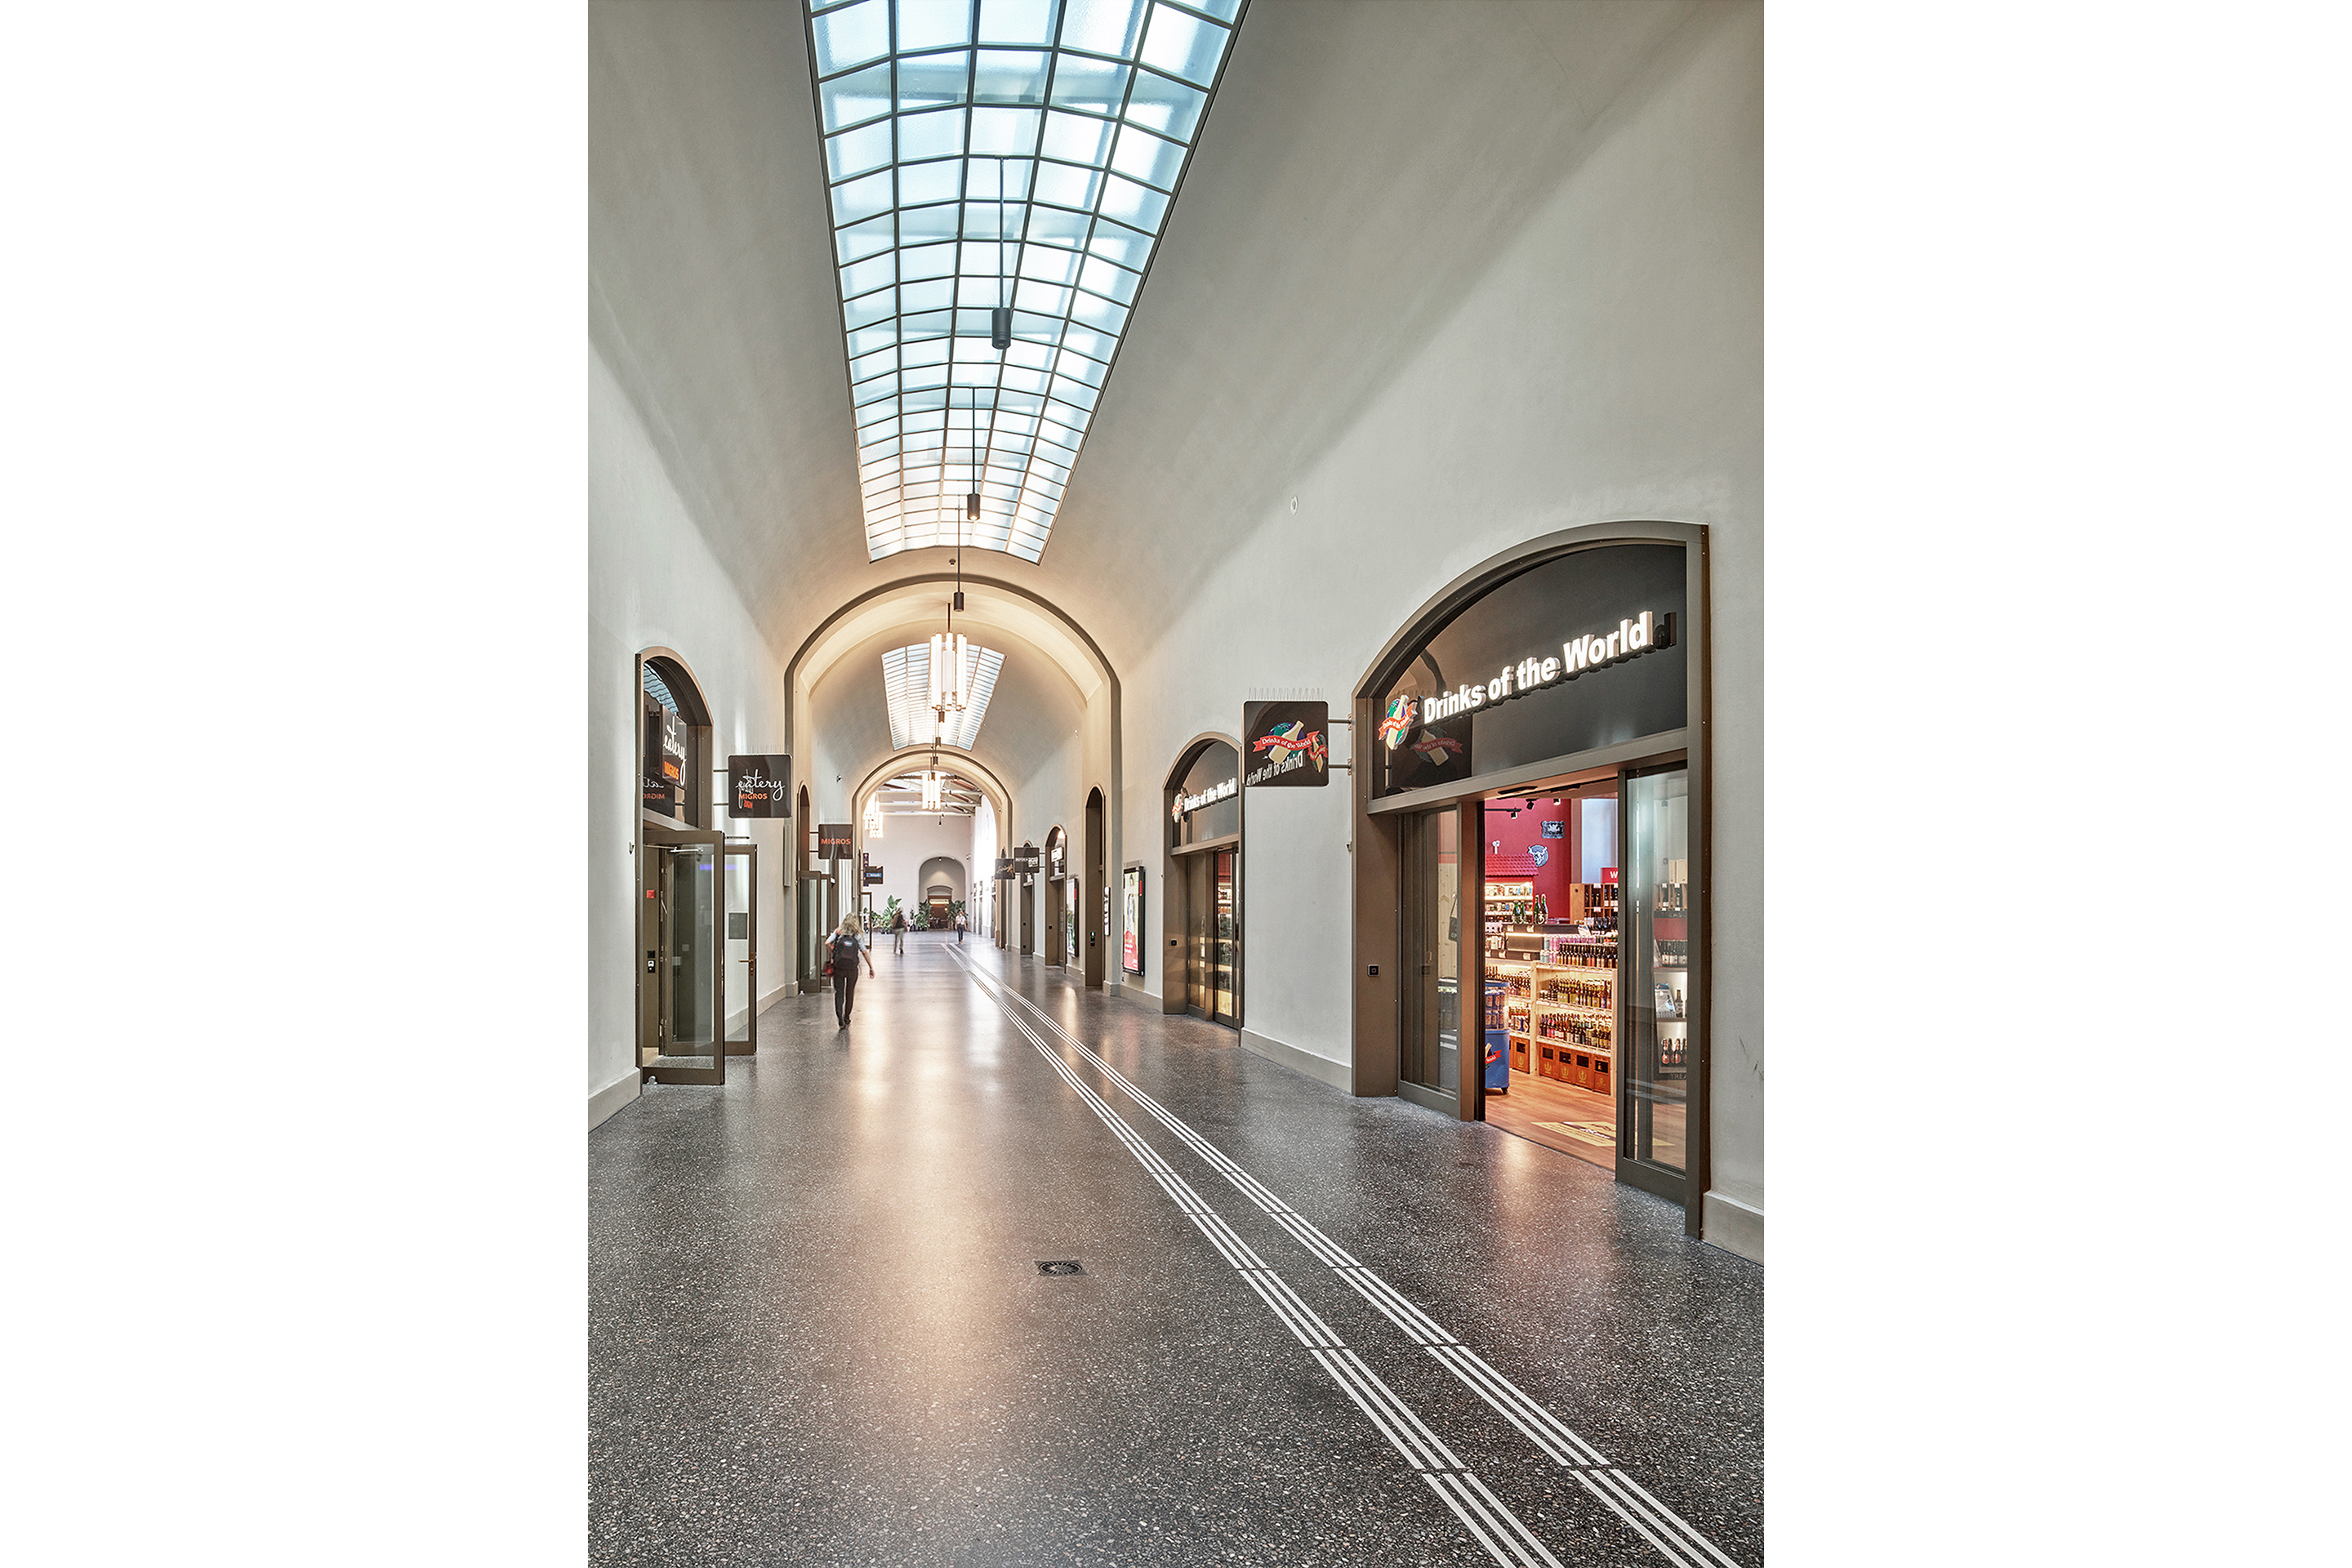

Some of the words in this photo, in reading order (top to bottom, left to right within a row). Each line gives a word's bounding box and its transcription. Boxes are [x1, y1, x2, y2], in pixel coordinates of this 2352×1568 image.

[1423, 684, 1486, 724] Drinks
[1488, 665, 1514, 701] of
[1516, 657, 1561, 691] the
[1562, 611, 1654, 674] World
[1261, 737, 1281, 745] Drinks
[1295, 738, 1312, 749] World
[735, 768, 786, 801] eatery
[738, 792, 768, 800] MIGROS
